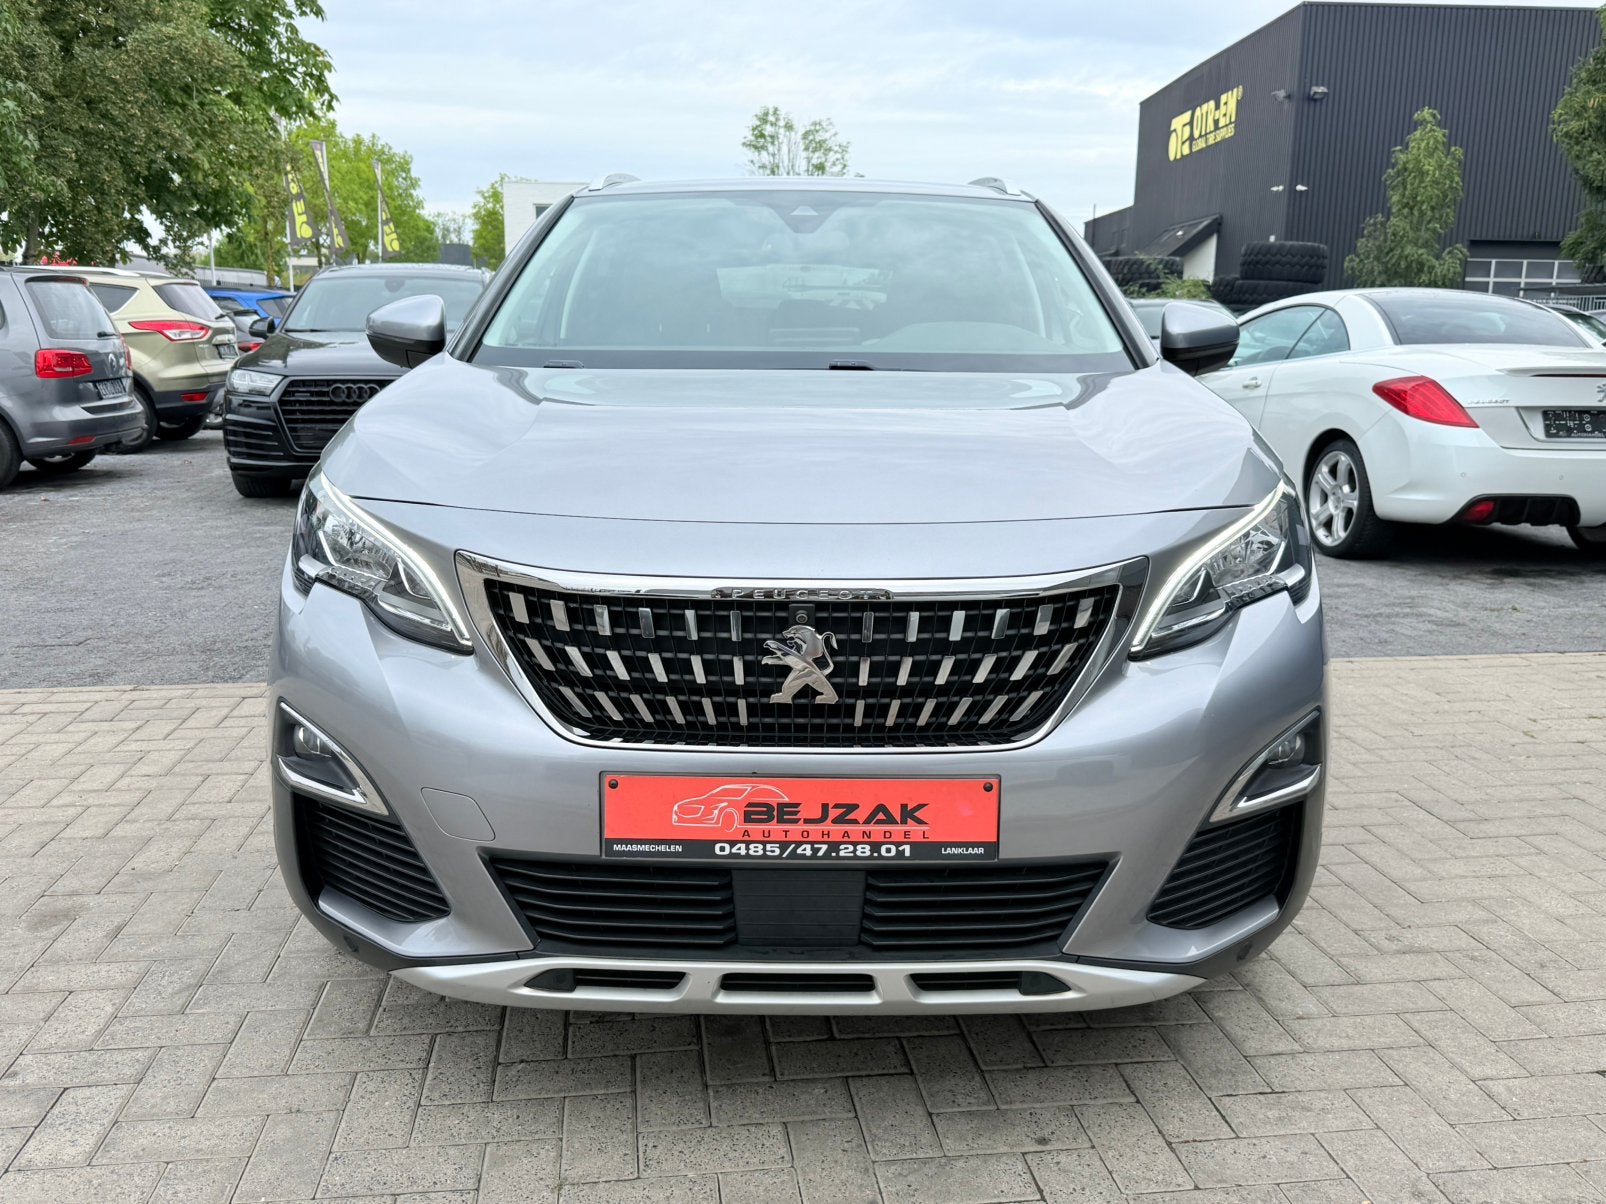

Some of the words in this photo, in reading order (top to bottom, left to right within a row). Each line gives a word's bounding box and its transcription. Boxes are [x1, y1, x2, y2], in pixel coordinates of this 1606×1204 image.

[731, 589, 873, 600] PEUGEOT
[743, 802, 930, 825] BEJZAK
[741, 829, 930, 840] AUTOHANDEL
[613, 843, 683, 852] MAASMECHELEN
[714, 842, 911, 857] 0485/47.28.01
[941, 847, 985, 855] LANKLAAR
